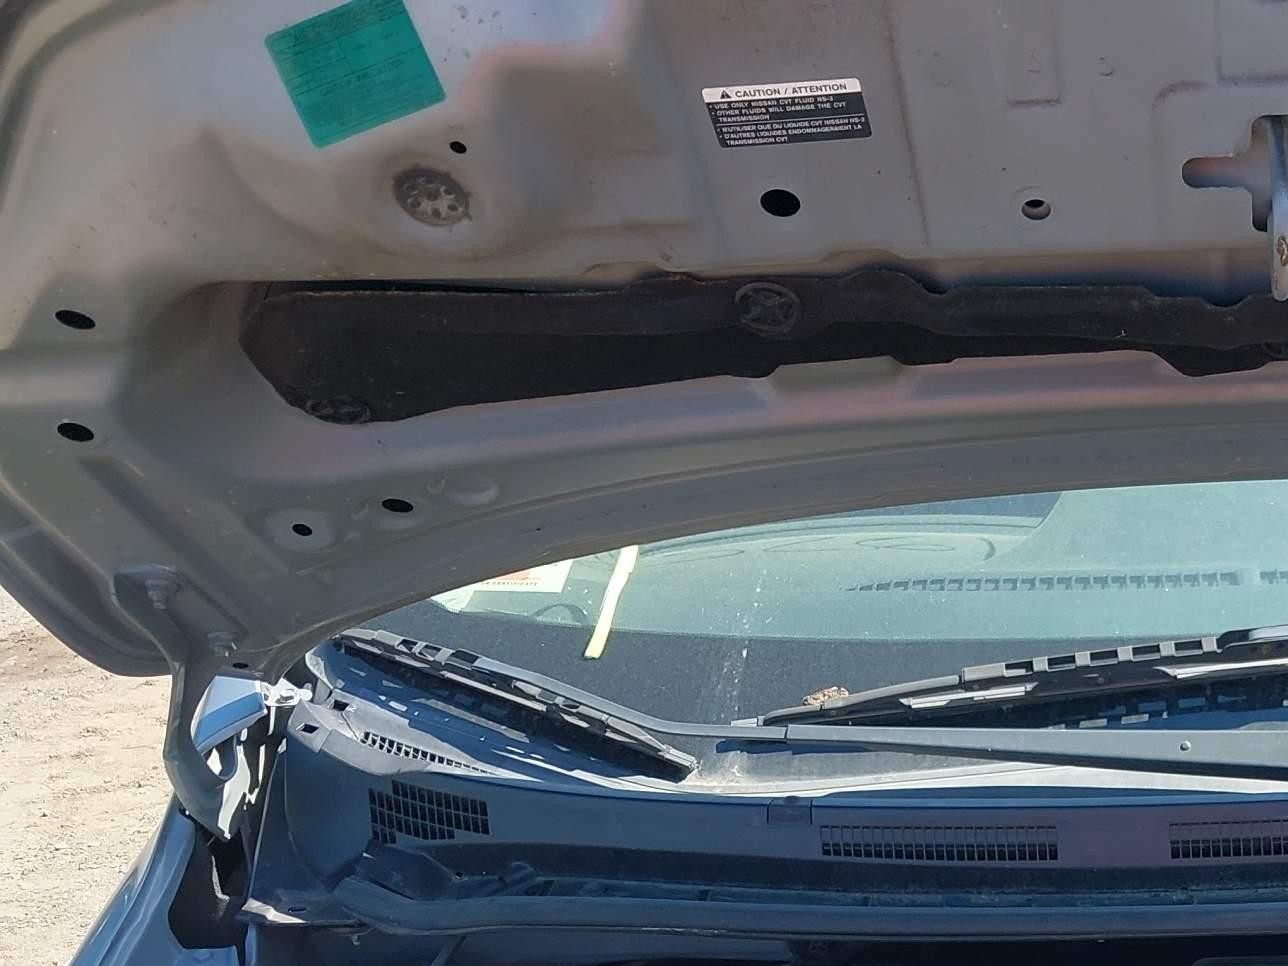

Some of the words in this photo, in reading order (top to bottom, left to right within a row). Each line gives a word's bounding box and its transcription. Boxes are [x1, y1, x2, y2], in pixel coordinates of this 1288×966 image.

[735, 88, 780, 98] CAUTION
[792, 84, 847, 94] ATTENTION
[726, 137, 775, 146] TRANSMISSION
